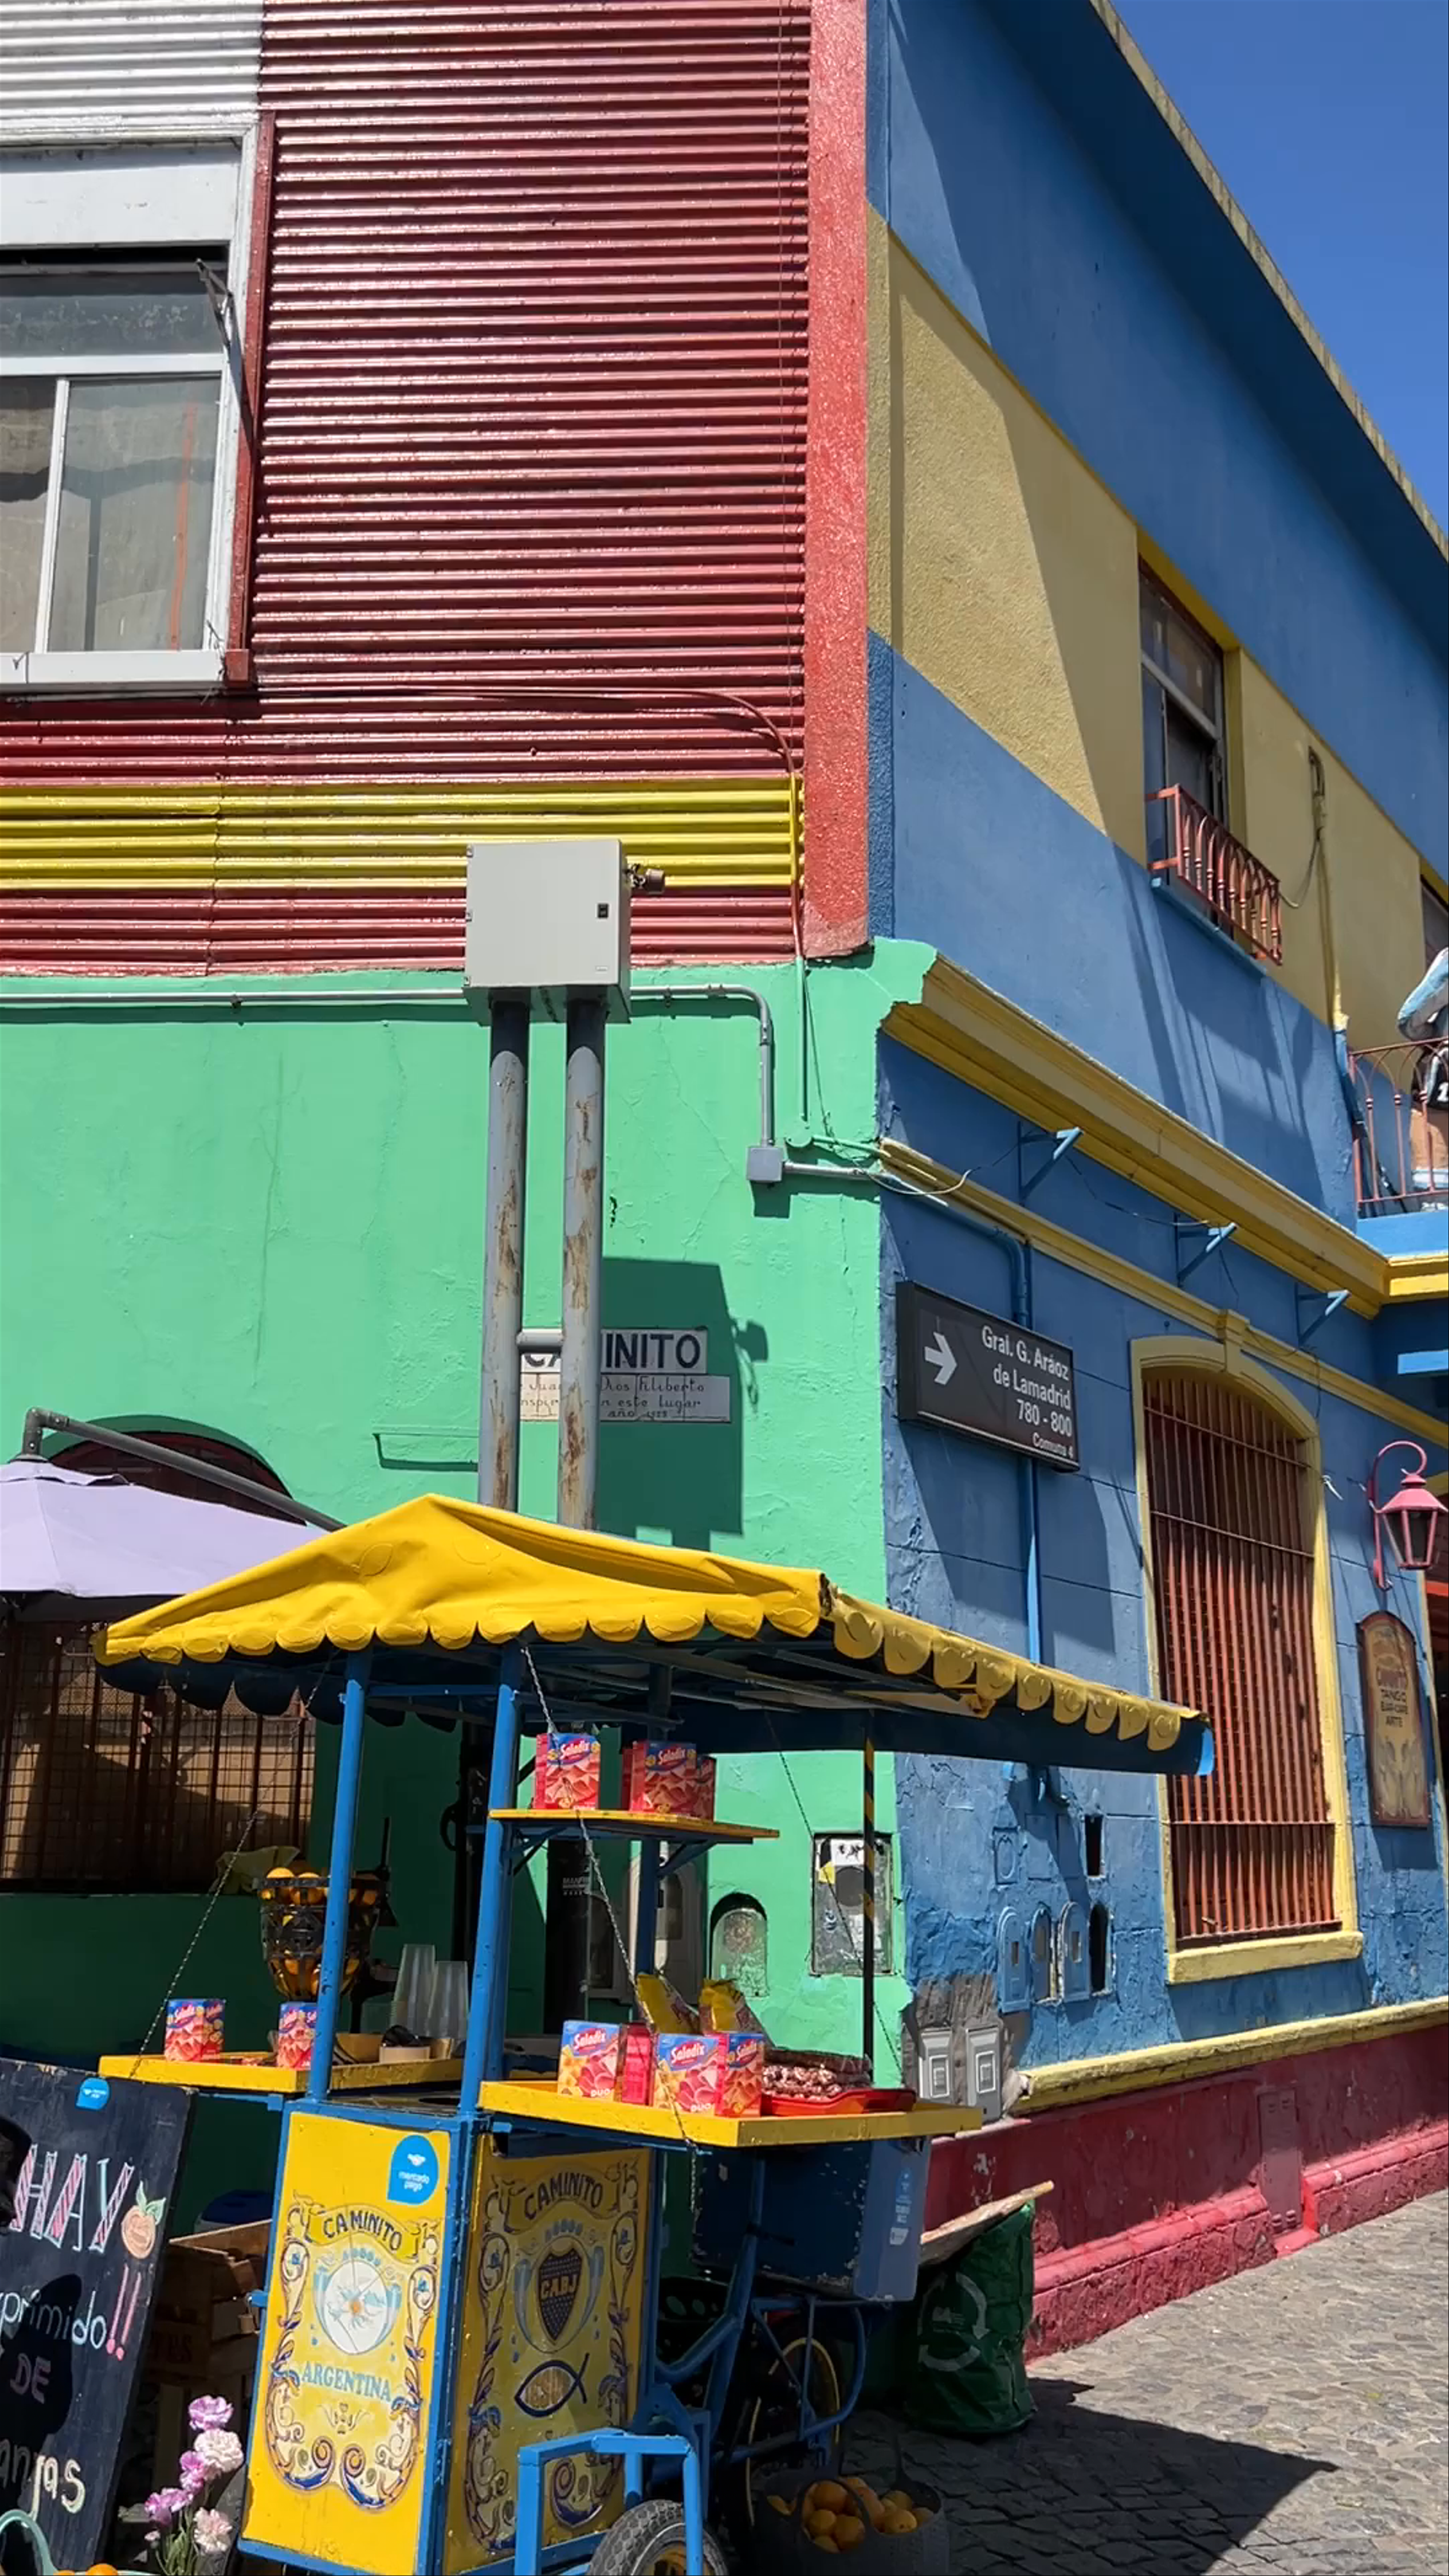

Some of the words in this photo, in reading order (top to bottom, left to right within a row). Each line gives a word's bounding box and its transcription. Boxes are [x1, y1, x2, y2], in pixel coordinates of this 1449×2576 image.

[525, 1333, 701, 1369] INITO
[982, 1325, 1013, 1357] Gral.
[1016, 1340, 1031, 1364] G.
[1034, 1347, 1069, 1381] Aráoz
[618, 1396, 648, 1408] este
[659, 1395, 701, 1414] lugar
[639, 1376, 705, 1392] Filiberto
[993, 1363, 1010, 1388] de
[1013, 1368, 1071, 1411] Lamadrid
[1016, 1398, 1040, 1426] 780
[1051, 1411, 1072, 1437] 800
[1032, 1432, 1067, 1456] Comuna
[1068, 1445, 1074, 1459] 4
[691, 2102, 712, 2113] DUO
[9, 2143, 135, 2254] HAY
[525, 2172, 603, 2220] CAMINITO
[323, 2210, 403, 2252] CAMINITO
[10, 2352, 52, 2404] DE
[302, 2361, 392, 2404] ARGENTINA
